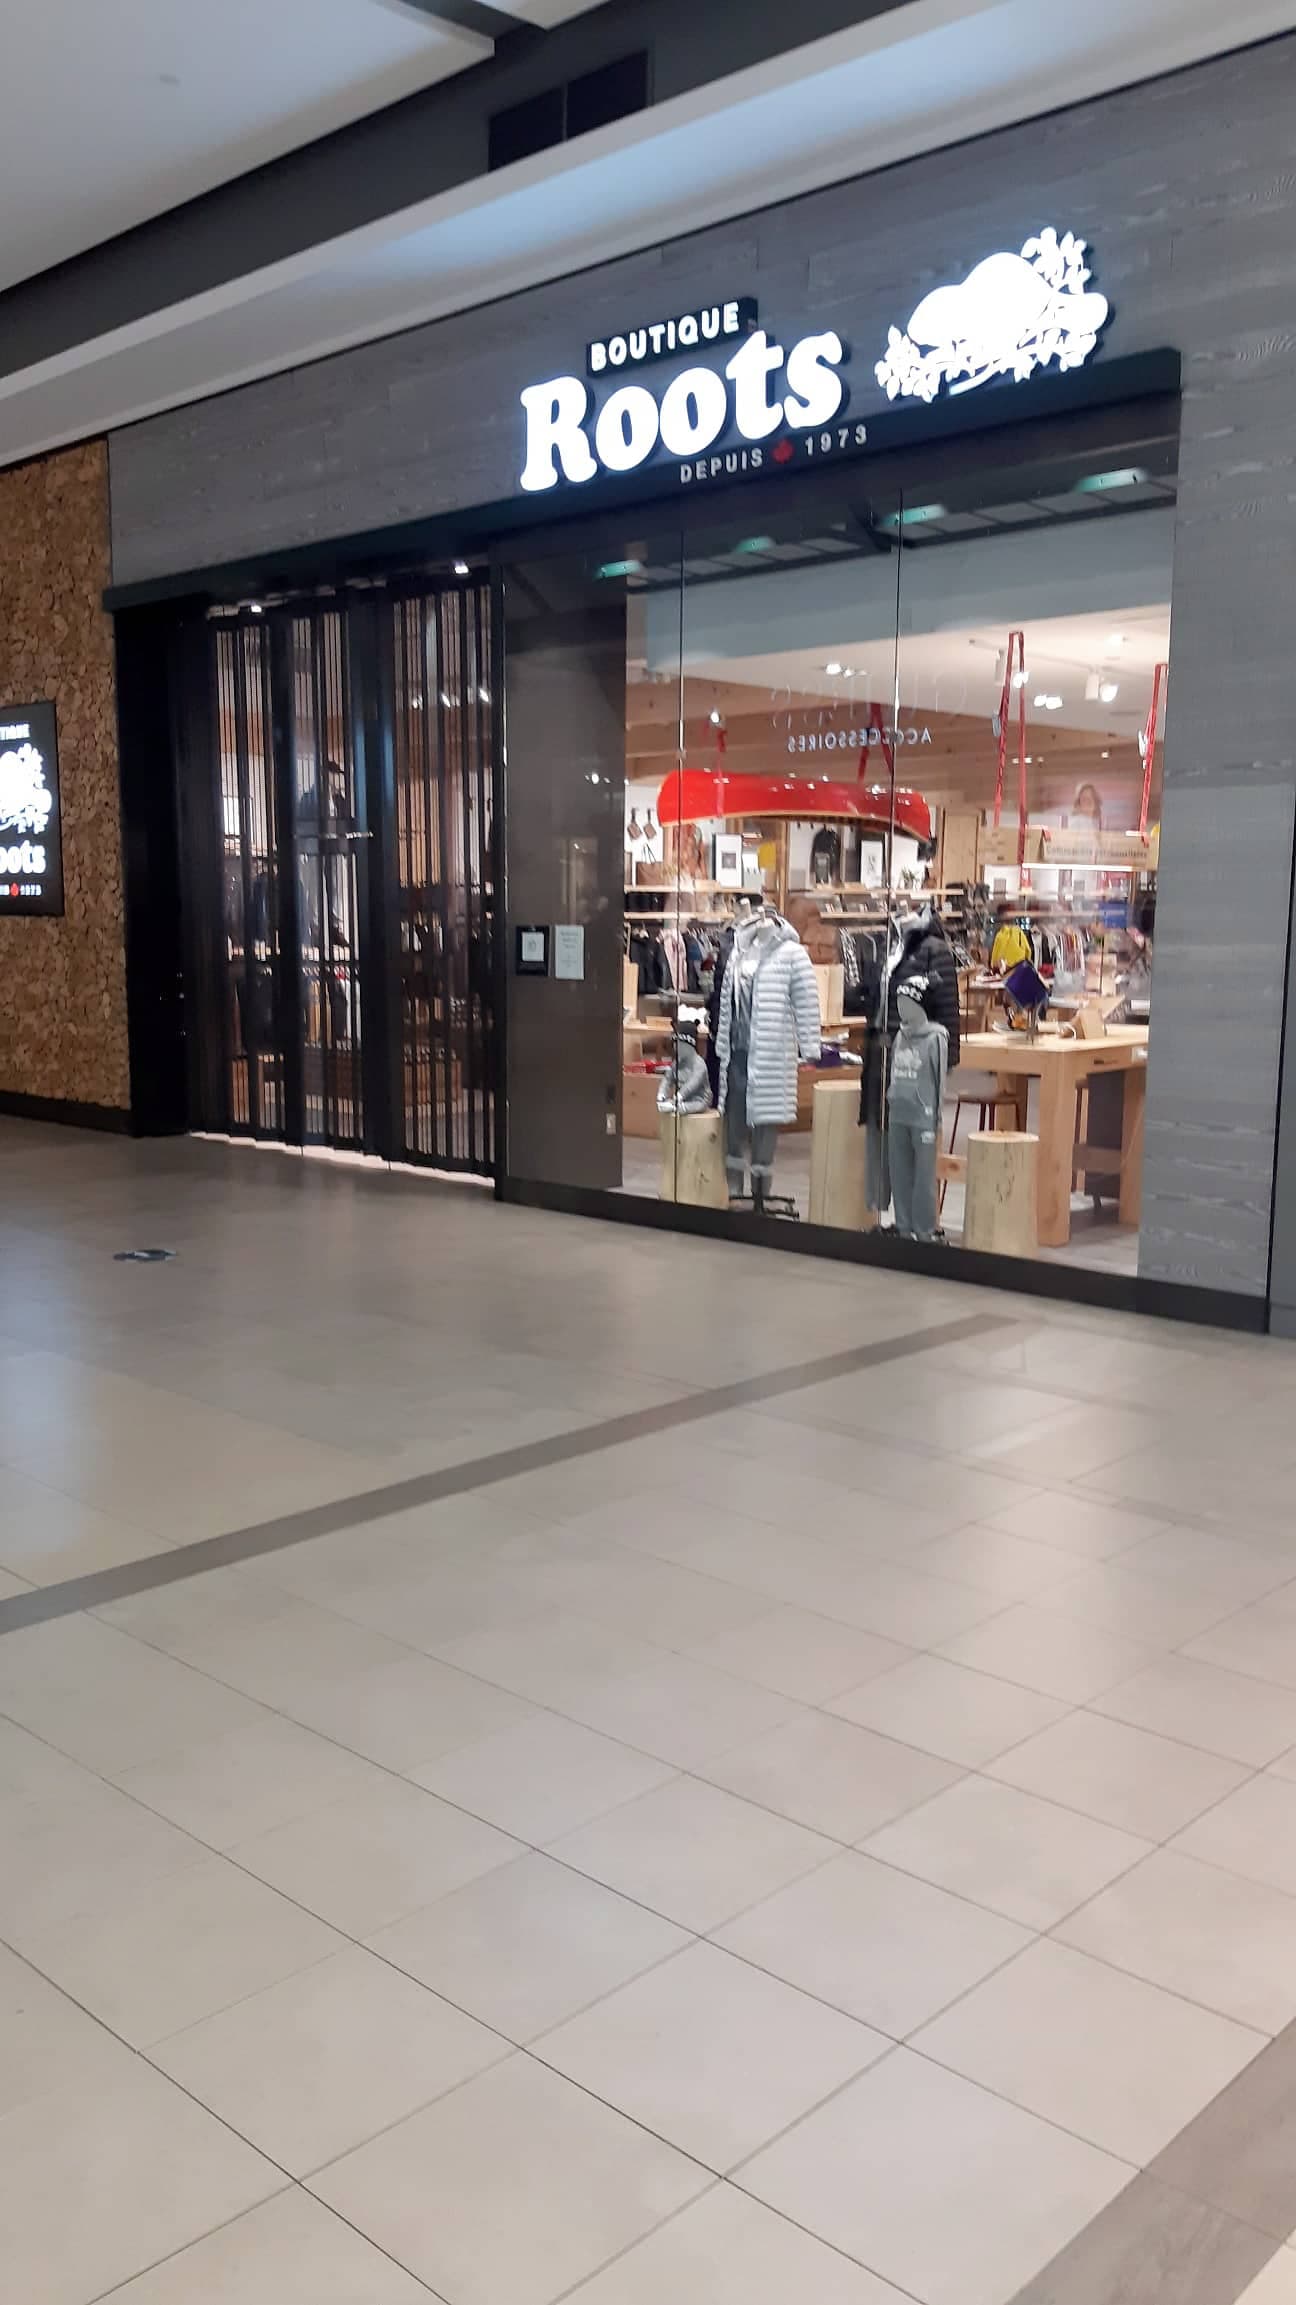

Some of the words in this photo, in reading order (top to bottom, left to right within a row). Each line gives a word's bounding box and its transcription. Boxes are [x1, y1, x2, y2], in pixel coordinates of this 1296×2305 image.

[591, 302, 739, 371] BOUTIQUE
[520, 330, 843, 492] Roots
[680, 448, 763, 483] DEPUIS
[805, 424, 867, 456] 1973
